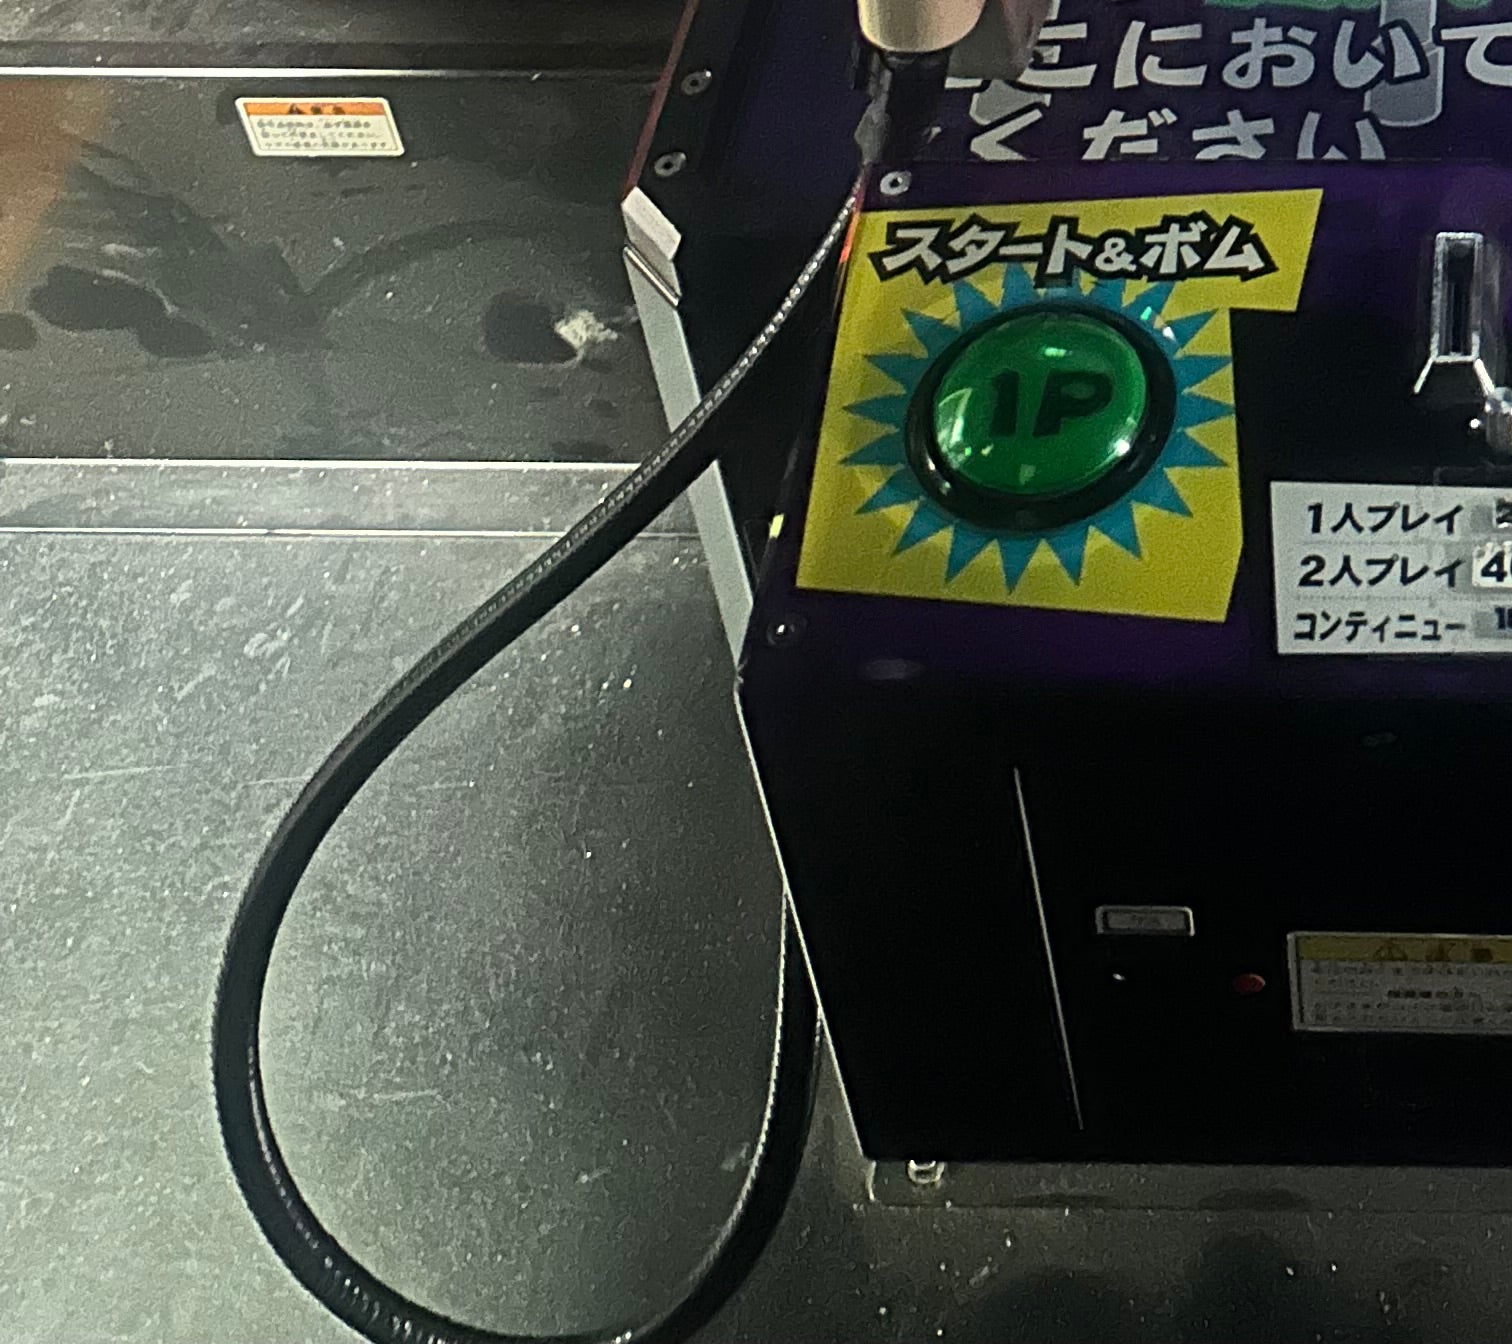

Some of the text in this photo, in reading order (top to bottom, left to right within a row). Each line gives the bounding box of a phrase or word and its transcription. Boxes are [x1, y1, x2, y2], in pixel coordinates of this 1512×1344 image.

[876, 216, 1270, 280] スタート&ボム
[989, 367, 1114, 439] 1P
[1306, 500, 1464, 534] 1人プレイ
[1297, 553, 1464, 588] 2人プレイ
[1292, 609, 1468, 644] コンティニュー
